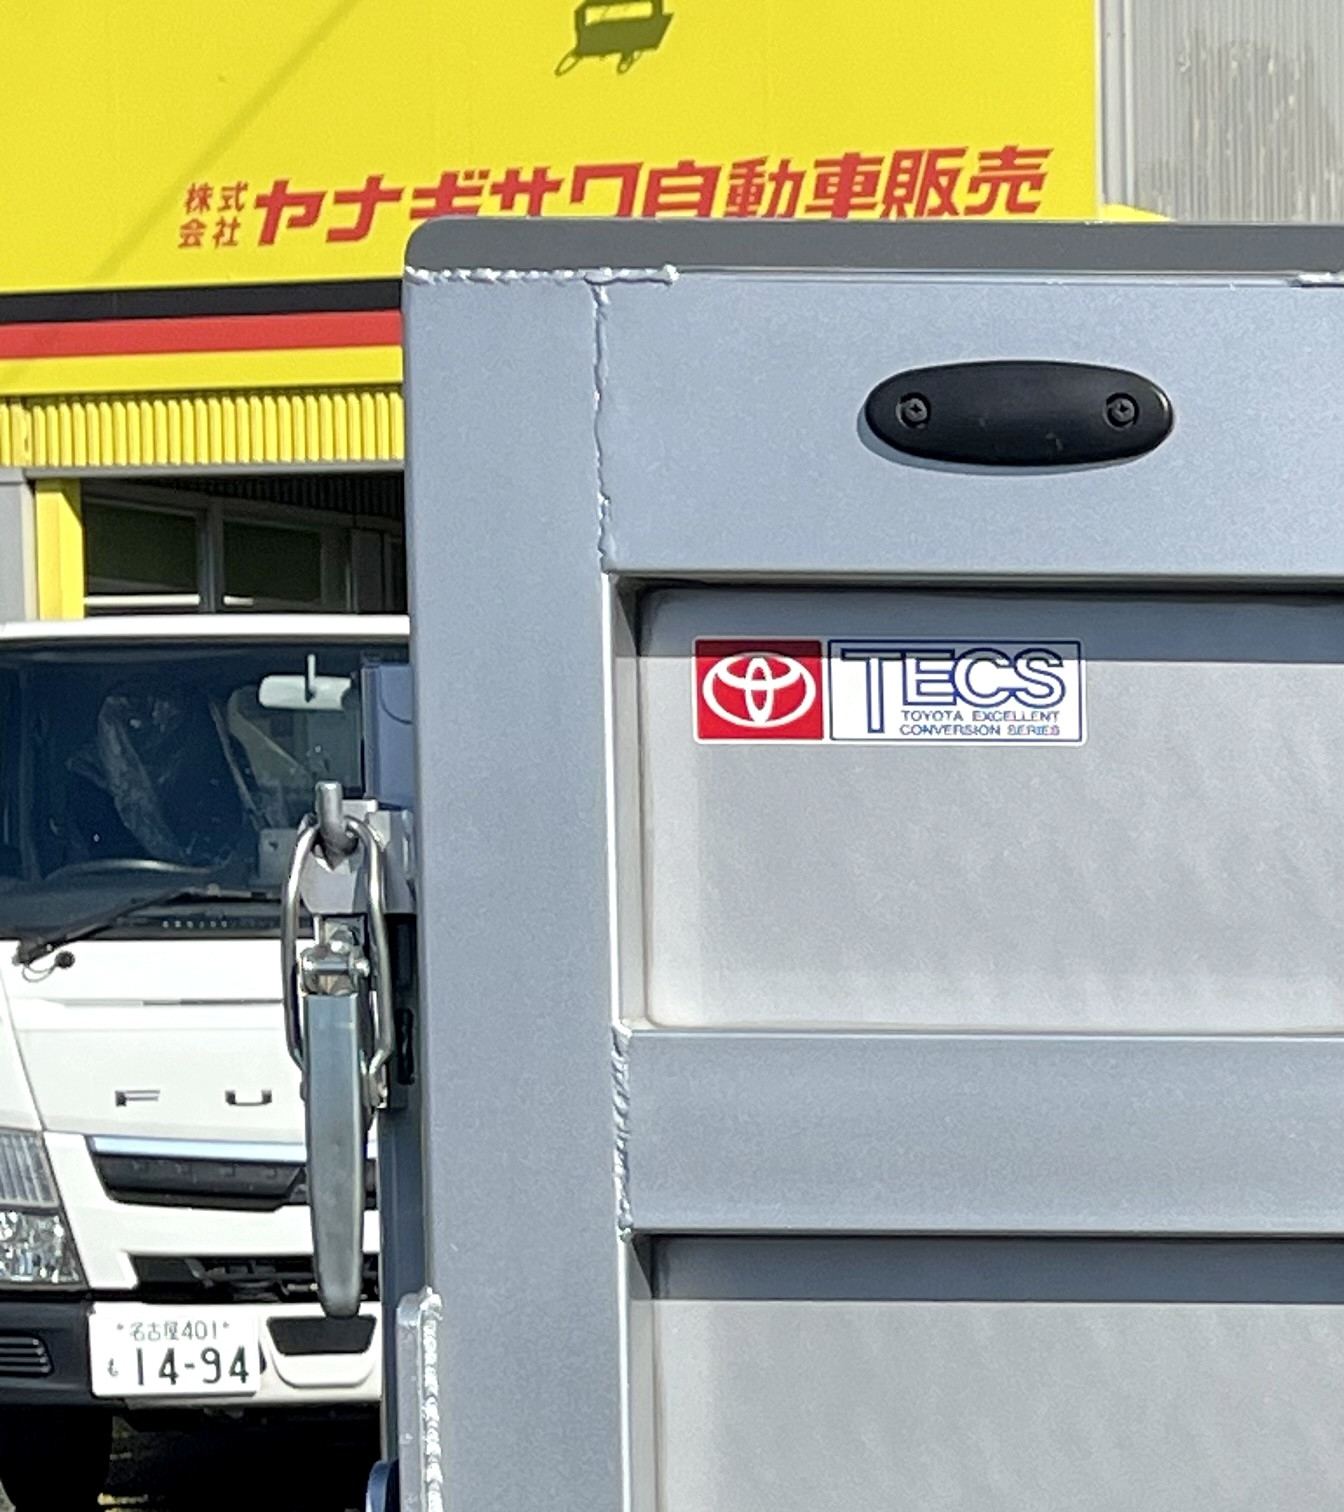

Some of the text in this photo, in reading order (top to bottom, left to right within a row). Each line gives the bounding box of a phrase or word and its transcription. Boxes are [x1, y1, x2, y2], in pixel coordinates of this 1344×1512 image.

[185, 181, 248, 213] 株式
[178, 216, 241, 248] 会社
[841, 648, 1066, 733] TECS
[900, 724, 1060, 736] CONVERSION SERIES
[901, 710, 1059, 722] TOYOTA EXCELLENT
[136, 1346, 249, 1386] 14-94
